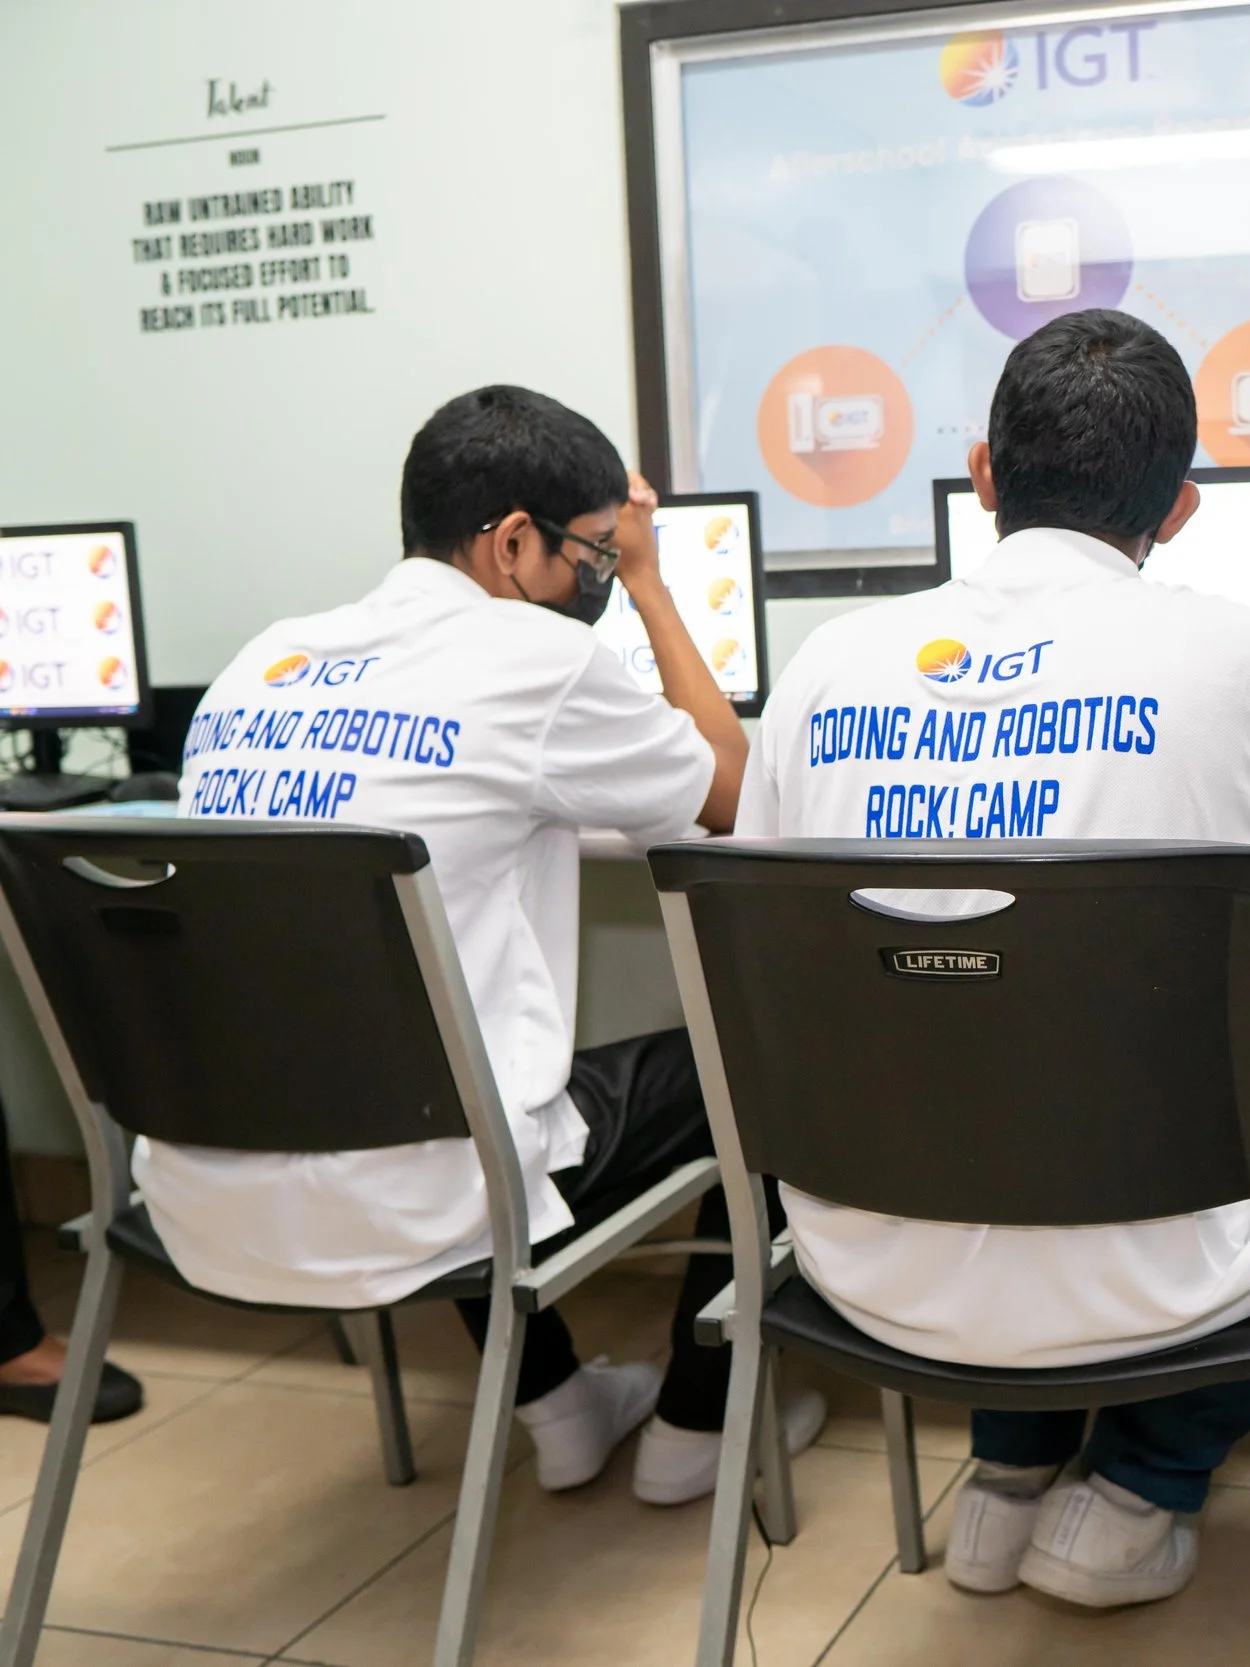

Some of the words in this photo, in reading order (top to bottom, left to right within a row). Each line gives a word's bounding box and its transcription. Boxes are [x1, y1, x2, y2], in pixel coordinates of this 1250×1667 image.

[1036, 20, 1158, 90] IGT
[143, 199, 182, 227] RAW
[188, 187, 283, 222] UNTRAINED
[290, 180, 355, 211] ABILITY
[132, 235, 172, 263] THAT
[179, 226, 261, 259] REQUIRES
[266, 221, 314, 249] HARD
[320, 215, 374, 242] WORK
[178, 263, 254, 294] FOCUSED
[259, 256, 320, 286] EFFORT
[329, 254, 350, 279] TO
[139, 304, 195, 333] REACH
[200, 302, 225, 327] ITS
[232, 297, 271, 323] FULL
[278, 288, 376, 319] POTENTIAL.
[10, 552, 57, 579] IGT
[17, 606, 62, 634] IGT
[21, 661, 67, 689] IGT
[311, 656, 382, 687] IGT
[977, 640, 1054, 684] IGT
[236, 708, 304, 751] AND
[301, 708, 461, 768] ROBOTICS
[810, 705, 911, 768] CODING
[914, 709, 987, 762] AND
[992, 695, 1159, 759] ROBOTICS
[189, 768, 267, 818] ROCK!
[267, 769, 357, 819] CAMP
[866, 784, 959, 838] ROCK!
[966, 779, 1060, 838] CAMP
[906, 954, 988, 970] LIFETIME
